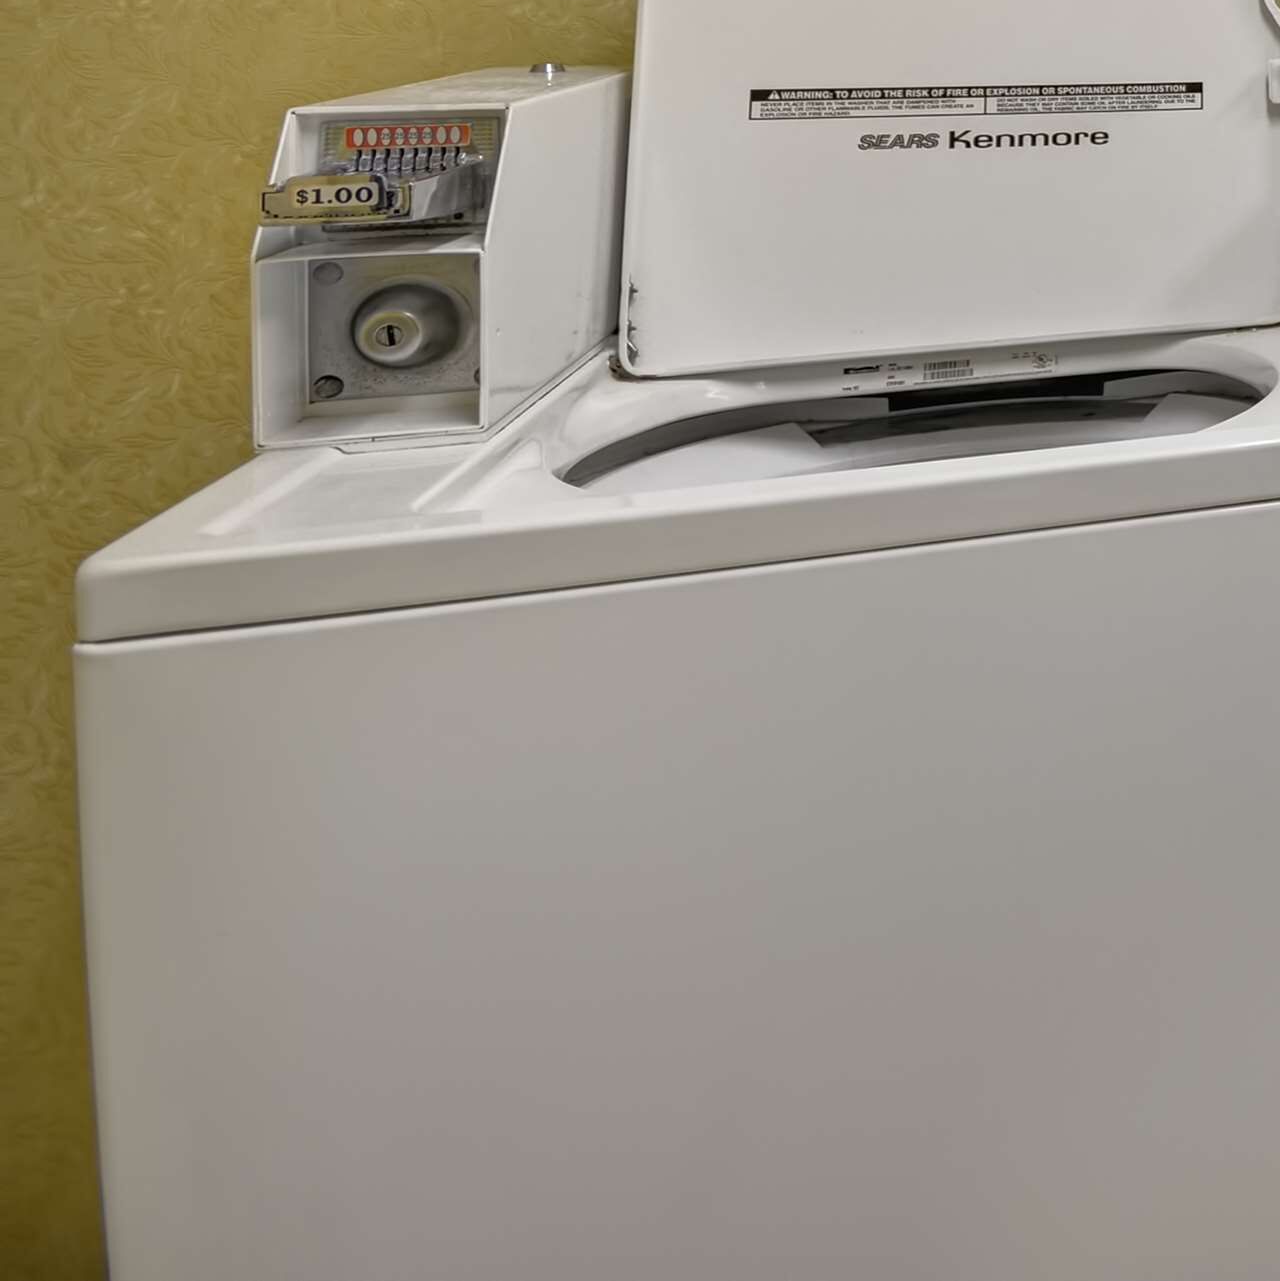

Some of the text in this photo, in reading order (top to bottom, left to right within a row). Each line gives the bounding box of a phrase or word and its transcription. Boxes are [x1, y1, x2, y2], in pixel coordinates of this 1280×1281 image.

[780, 91, 833, 99] WARNING:
[851, 90, 881, 98] AVOID
[883, 90, 904, 98] THE
[906, 89, 930, 97] RISK
[931, 89, 945, 97] OF
[970, 88, 984, 96] OR
[986, 87, 1040, 96] EXPLOSION
[1042, 87, 1056, 95] OR
[1057, 86, 1124, 95] SPONTANEOUS
[1126, 85, 1186, 93] COMBUSTION
[858, 130, 1109, 150] SEARS Kenmore
[296, 187, 373, 206] $1.00
